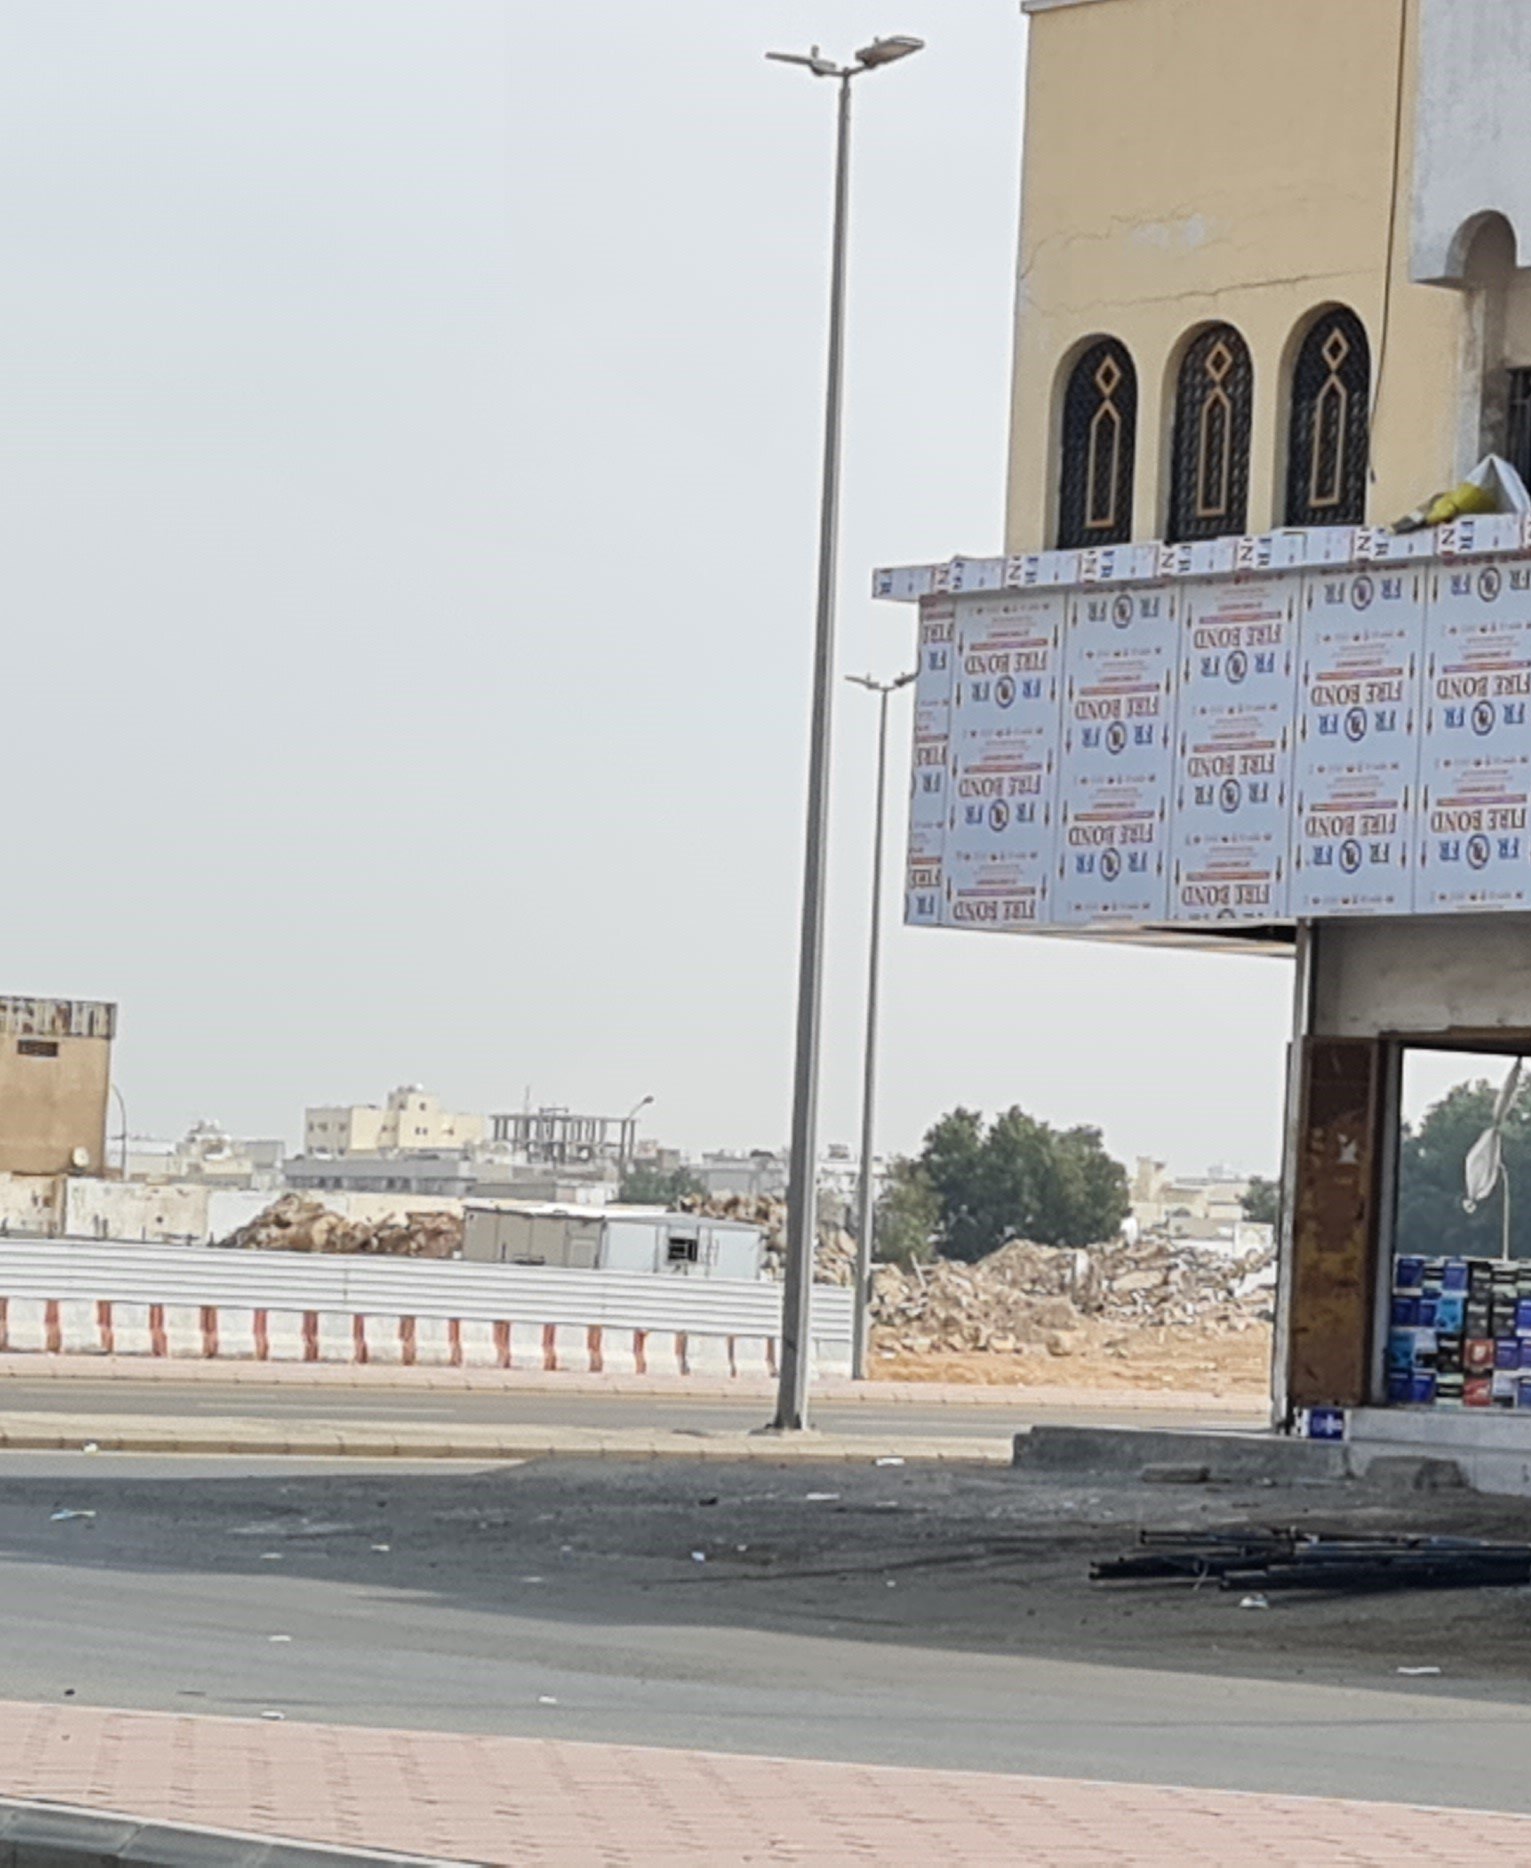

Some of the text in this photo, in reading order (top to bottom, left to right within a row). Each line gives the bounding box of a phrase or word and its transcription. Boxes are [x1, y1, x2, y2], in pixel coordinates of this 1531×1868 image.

[1325, 578, 1401, 604] FR FR
[1450, 569, 1531, 595] FR FR
[1089, 597, 1160, 621] FR FR
[1194, 623, 1281, 648] FIRE BOND
[965, 653, 1047, 674] FIRE BOND
[1201, 653, 1275, 676] FR FR
[972, 678, 1041, 701] FR FR
[1312, 681, 1402, 706] FIRE BOND
[1437, 673, 1531, 698] FIRE BOND
[1075, 696, 1160, 720] FIRE BOND
[1444, 702, 1525, 727] FR FR
[1319, 710, 1396, 733] FR FR
[1082, 725, 1153, 747] FR FR
[1188, 754, 1275, 777] FIRE BOND
[959, 775, 1041, 797] FIRE BOND
[1195, 782, 1268, 805] FR FR
[965, 803, 1035, 825] FR FR
[1306, 813, 1396, 837] FIRE BOND
[1431, 808, 1526, 832] FIRE BOND
[1069, 824, 1153, 846] FIRE BOND
[1313, 843, 1390, 865] FR FR
[1439, 837, 1519, 861] FR FR
[1076, 852, 1147, 873] FR FR
[1182, 885, 1270, 905] FIRE BOND
[953, 900, 1036, 921] FIRE BOND
